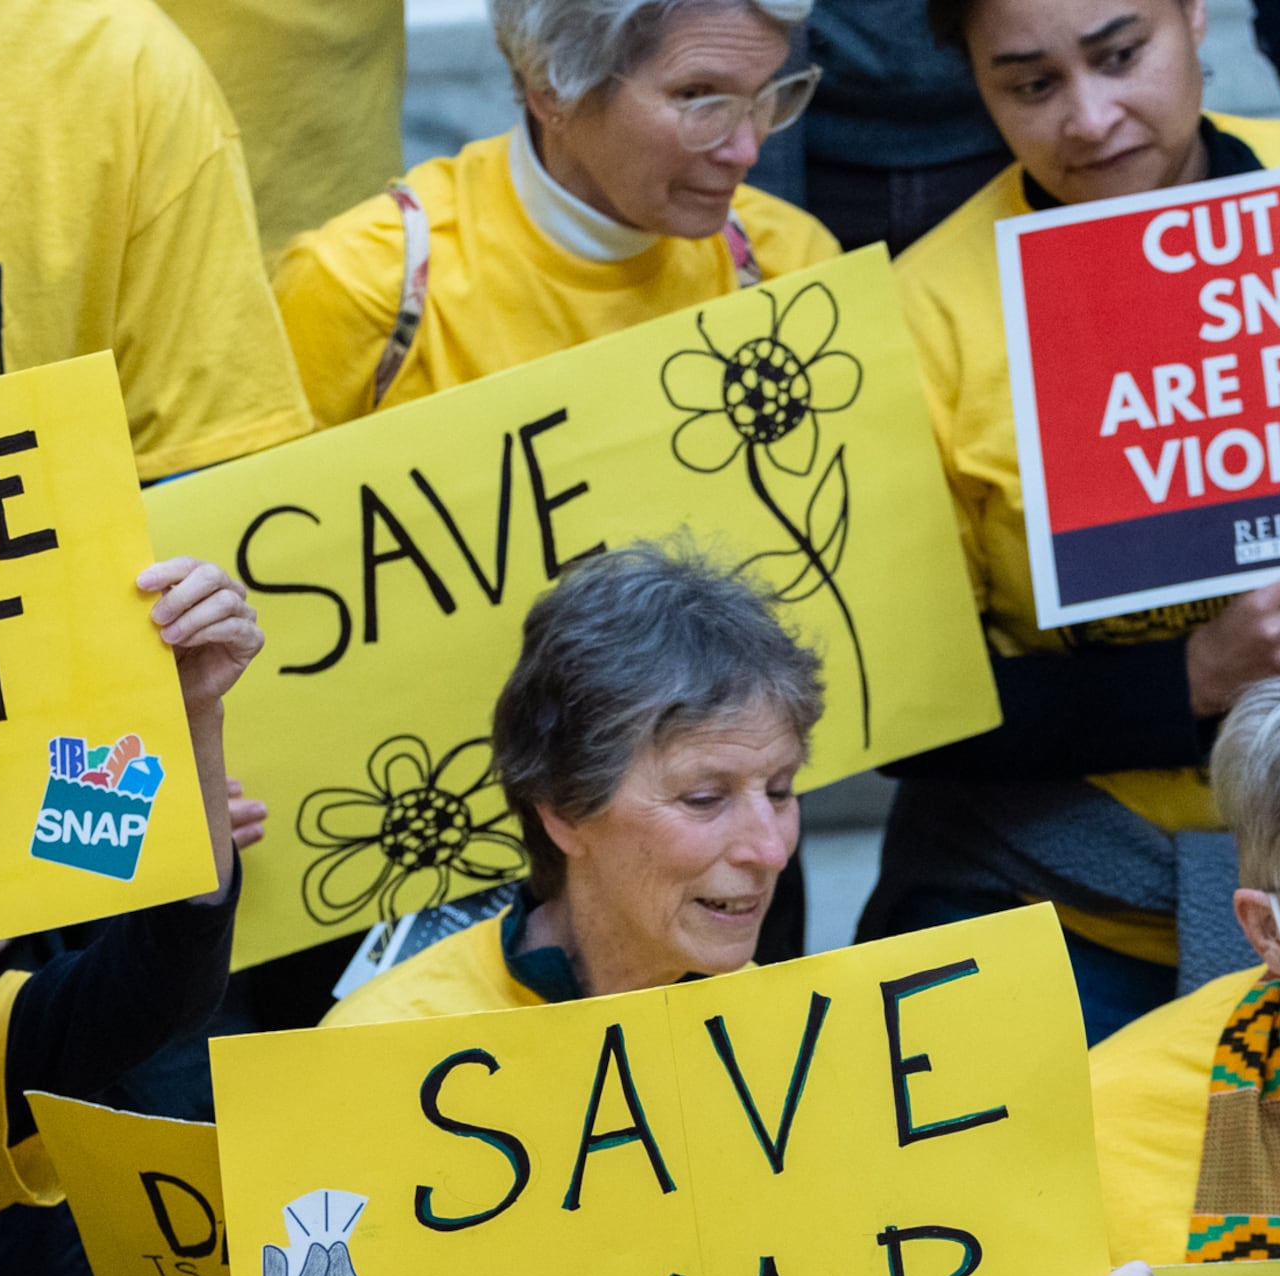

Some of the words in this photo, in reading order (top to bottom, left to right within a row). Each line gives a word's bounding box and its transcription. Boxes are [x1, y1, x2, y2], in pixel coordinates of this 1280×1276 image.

[1100, 354, 1243, 437] ARE
[236, 408, 607, 675] SAVE
[36, 808, 147, 847] SNAP
[414, 957, 1009, 1232] SAVE
